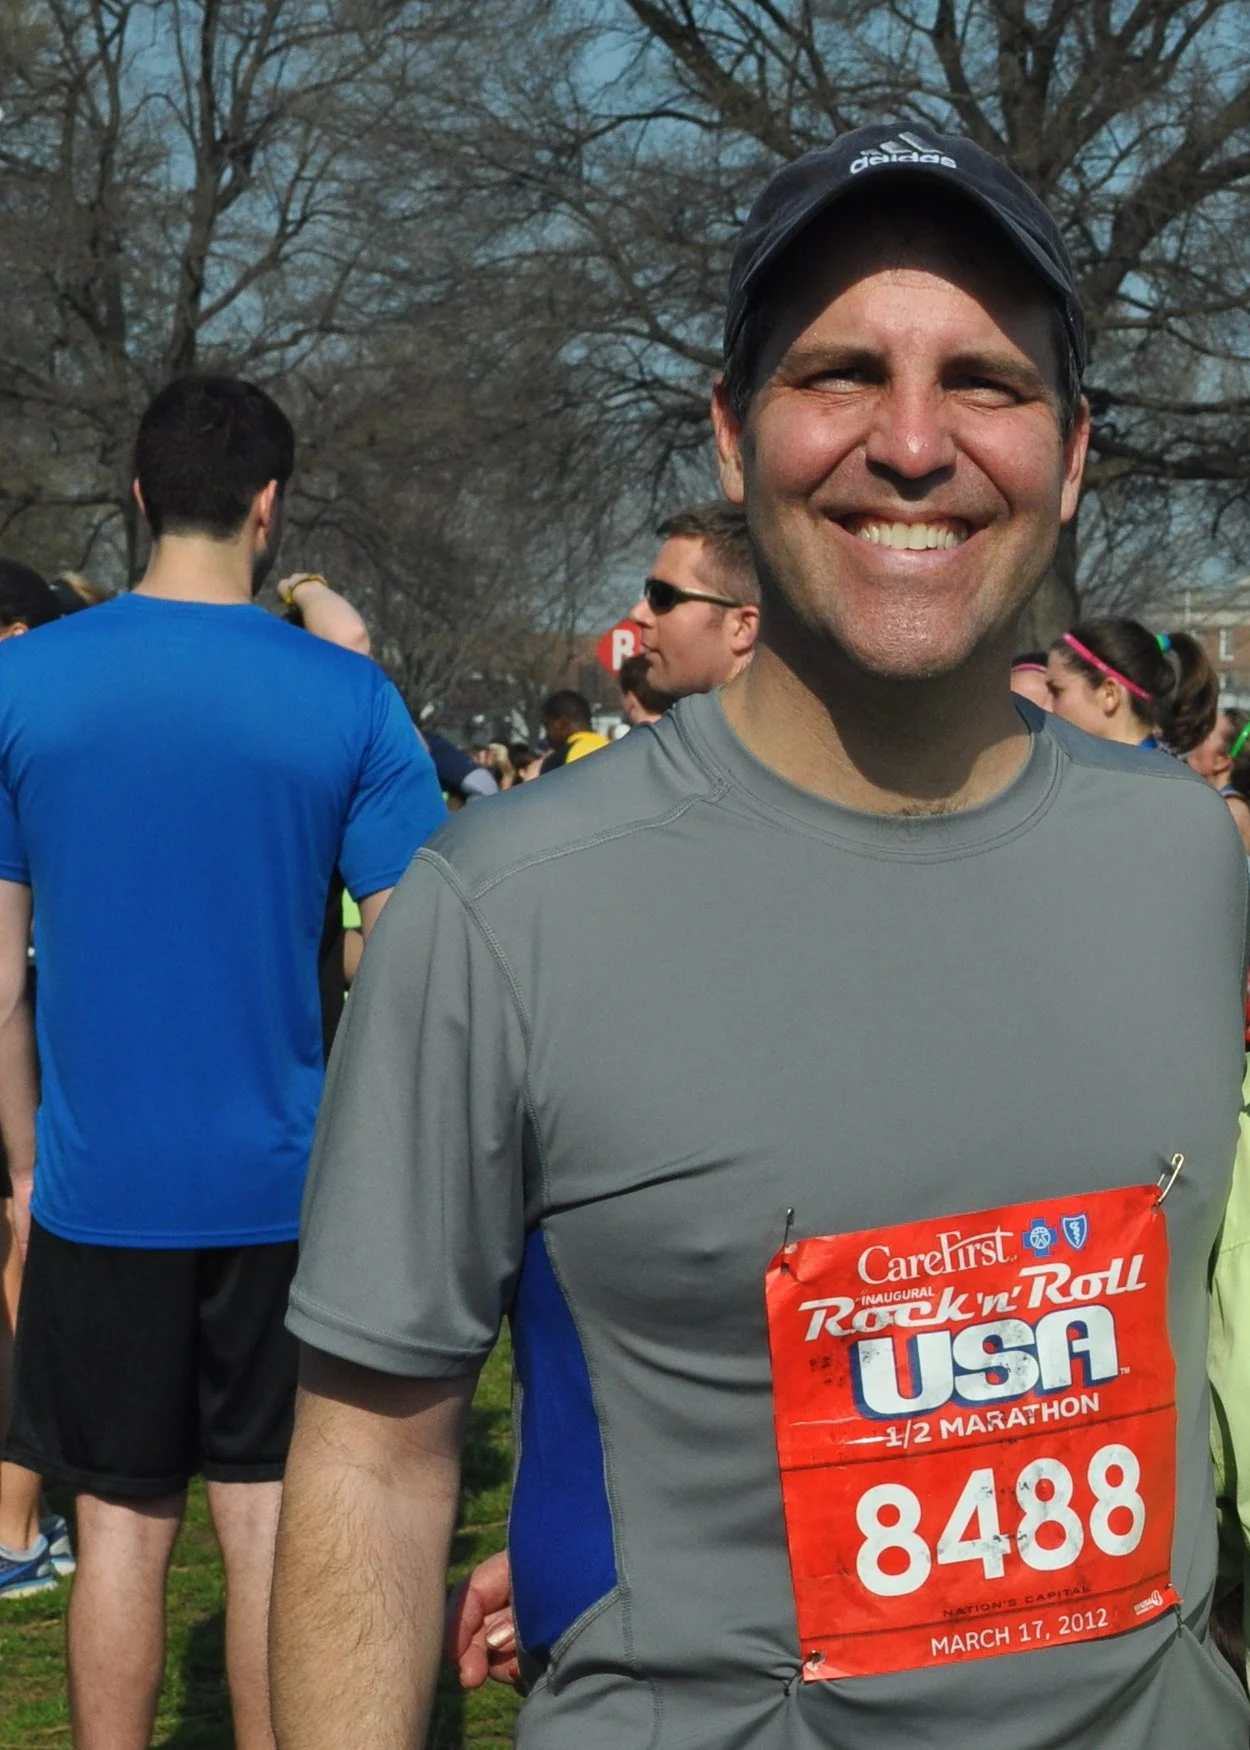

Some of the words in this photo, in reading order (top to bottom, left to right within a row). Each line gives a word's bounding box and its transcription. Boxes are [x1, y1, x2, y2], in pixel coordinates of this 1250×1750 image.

[850, 152, 957, 174] adidas
[612, 629, 635, 671] R
[858, 1225, 1014, 1285] CareFirst
[798, 1286, 975, 1342] Rock
[1018, 1254, 1147, 1309] Roll
[861, 1286, 935, 1305] INAUGURAL
[854, 1304, 1119, 1420] USA
[886, 1419, 932, 1449] 1/2
[940, 1392, 1101, 1440] MARATHON
[856, 1444, 1146, 1597] 8488
[1024, 1585, 1092, 1604] CAPITAL
[931, 1626, 1010, 1657] MARCH
[1018, 1620, 1051, 1642] 17,
[1058, 1608, 1109, 1635] 2012
